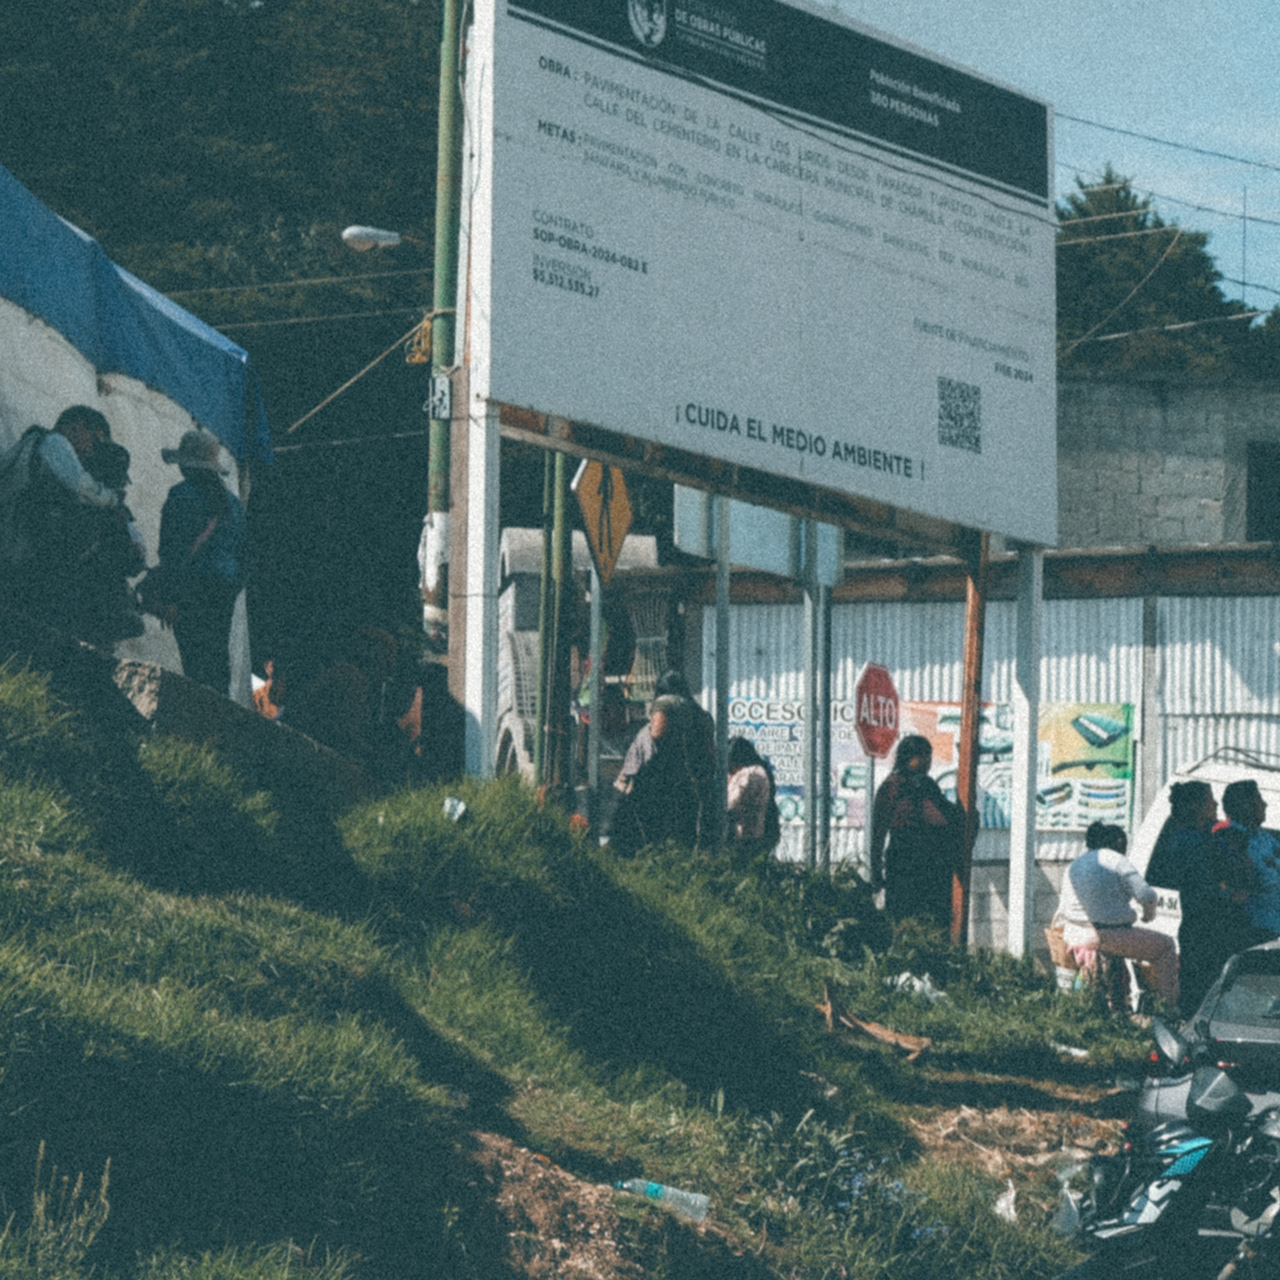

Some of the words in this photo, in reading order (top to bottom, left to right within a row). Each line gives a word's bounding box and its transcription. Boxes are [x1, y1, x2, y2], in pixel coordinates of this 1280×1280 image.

[689, 13, 720, 35] OBRAS
[584, 92, 618, 118] CALLE
[625, 106, 647, 128] DEL
[889, 97, 938, 127] PERSONAS
[728, 121, 761, 146] CALLE
[532, 207, 594, 240] CONTRATO
[684, 400, 740, 437] CUIDA
[746, 416, 766, 443] EL
[771, 422, 826, 458] MEDIO
[831, 436, 912, 480] AMBIENTE
[860, 694, 896, 730] ALTO
